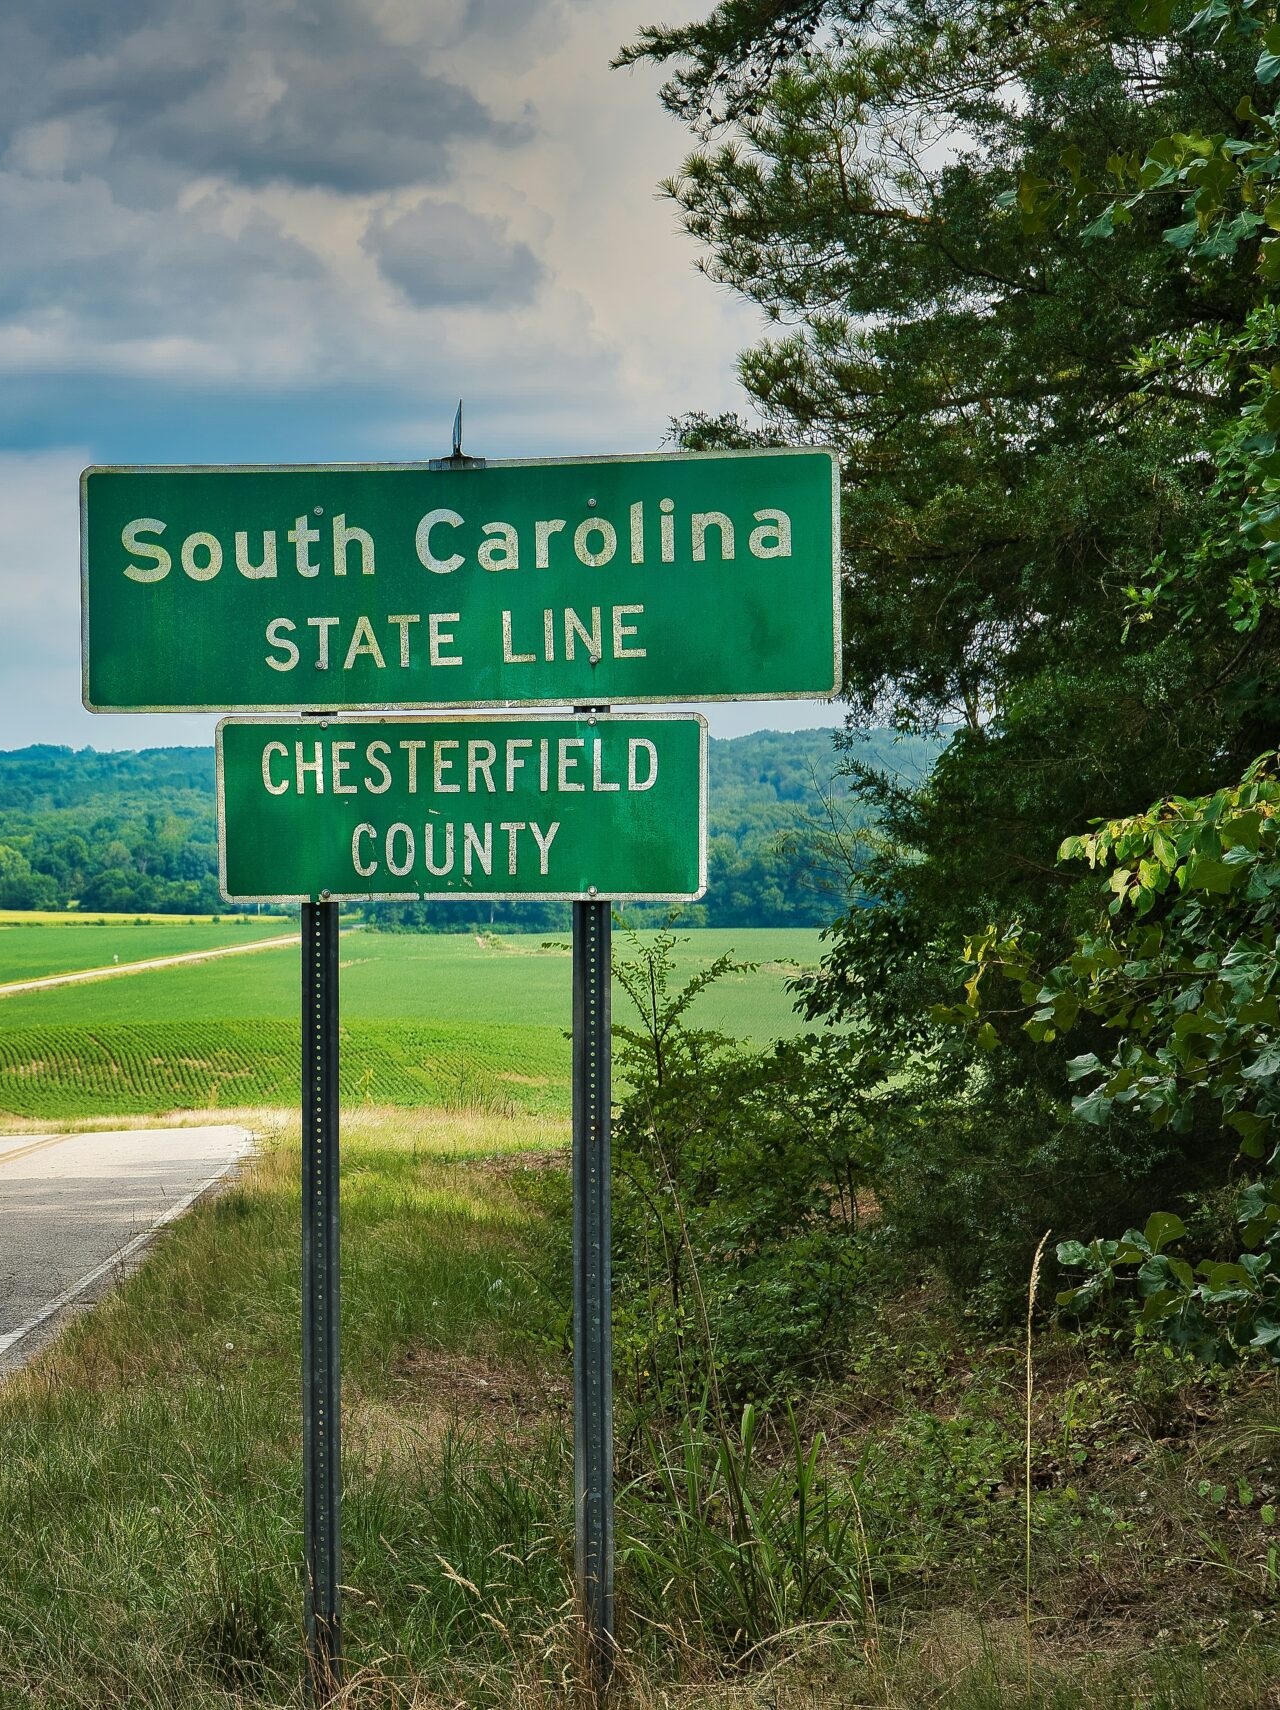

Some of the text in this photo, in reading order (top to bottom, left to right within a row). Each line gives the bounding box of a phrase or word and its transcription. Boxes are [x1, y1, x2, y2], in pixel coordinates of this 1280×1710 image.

[121, 497, 792, 583] South Carolina
[265, 603, 648, 672] STATE LINE
[261, 737, 659, 796] CHESTERFIELD
[351, 821, 561, 877] COUNTY
